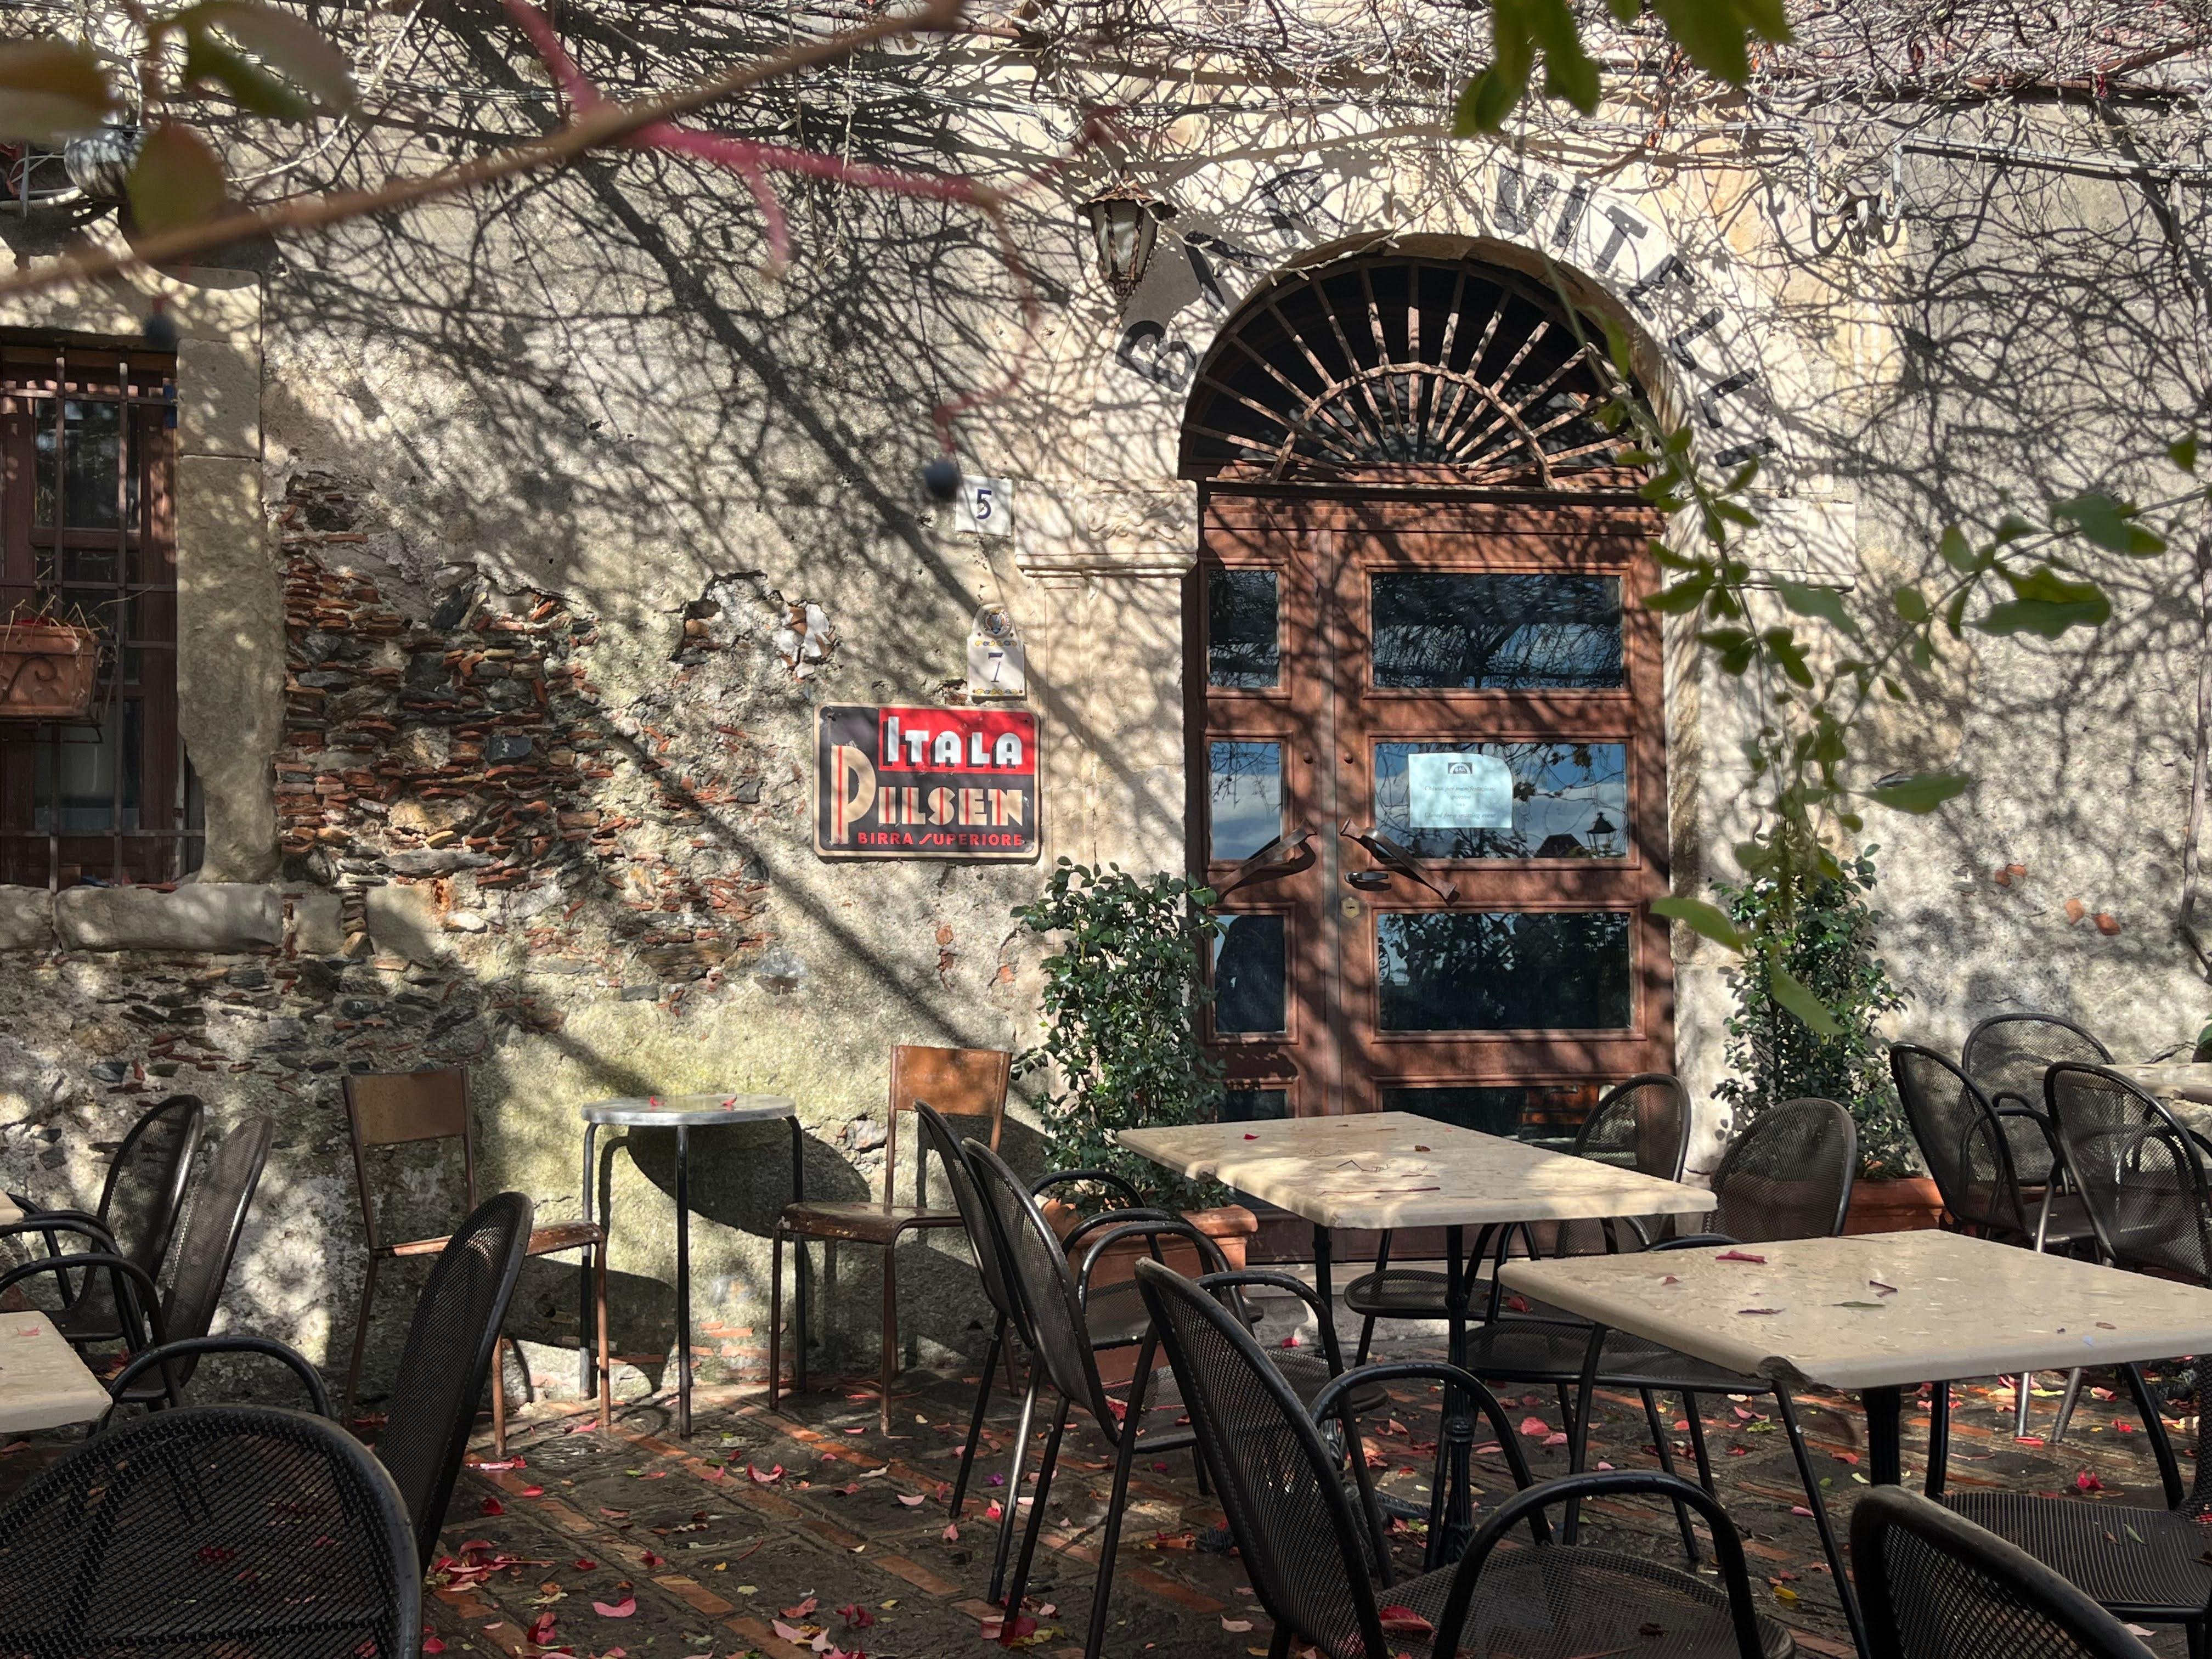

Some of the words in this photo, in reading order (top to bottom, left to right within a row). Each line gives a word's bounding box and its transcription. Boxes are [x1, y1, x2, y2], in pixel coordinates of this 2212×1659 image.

[1115, 167, 1338, 393] BAR
[1493, 163, 1776, 467] VITELLI
[975, 488, 992, 520] 5
[988, 652, 1003, 683] 7
[884, 716, 1023, 766] ITALA
[830, 745, 1023, 844] PILSEN
[857, 832, 913, 845] BIRRA
[918, 832, 1023, 847] SUPERIORE
